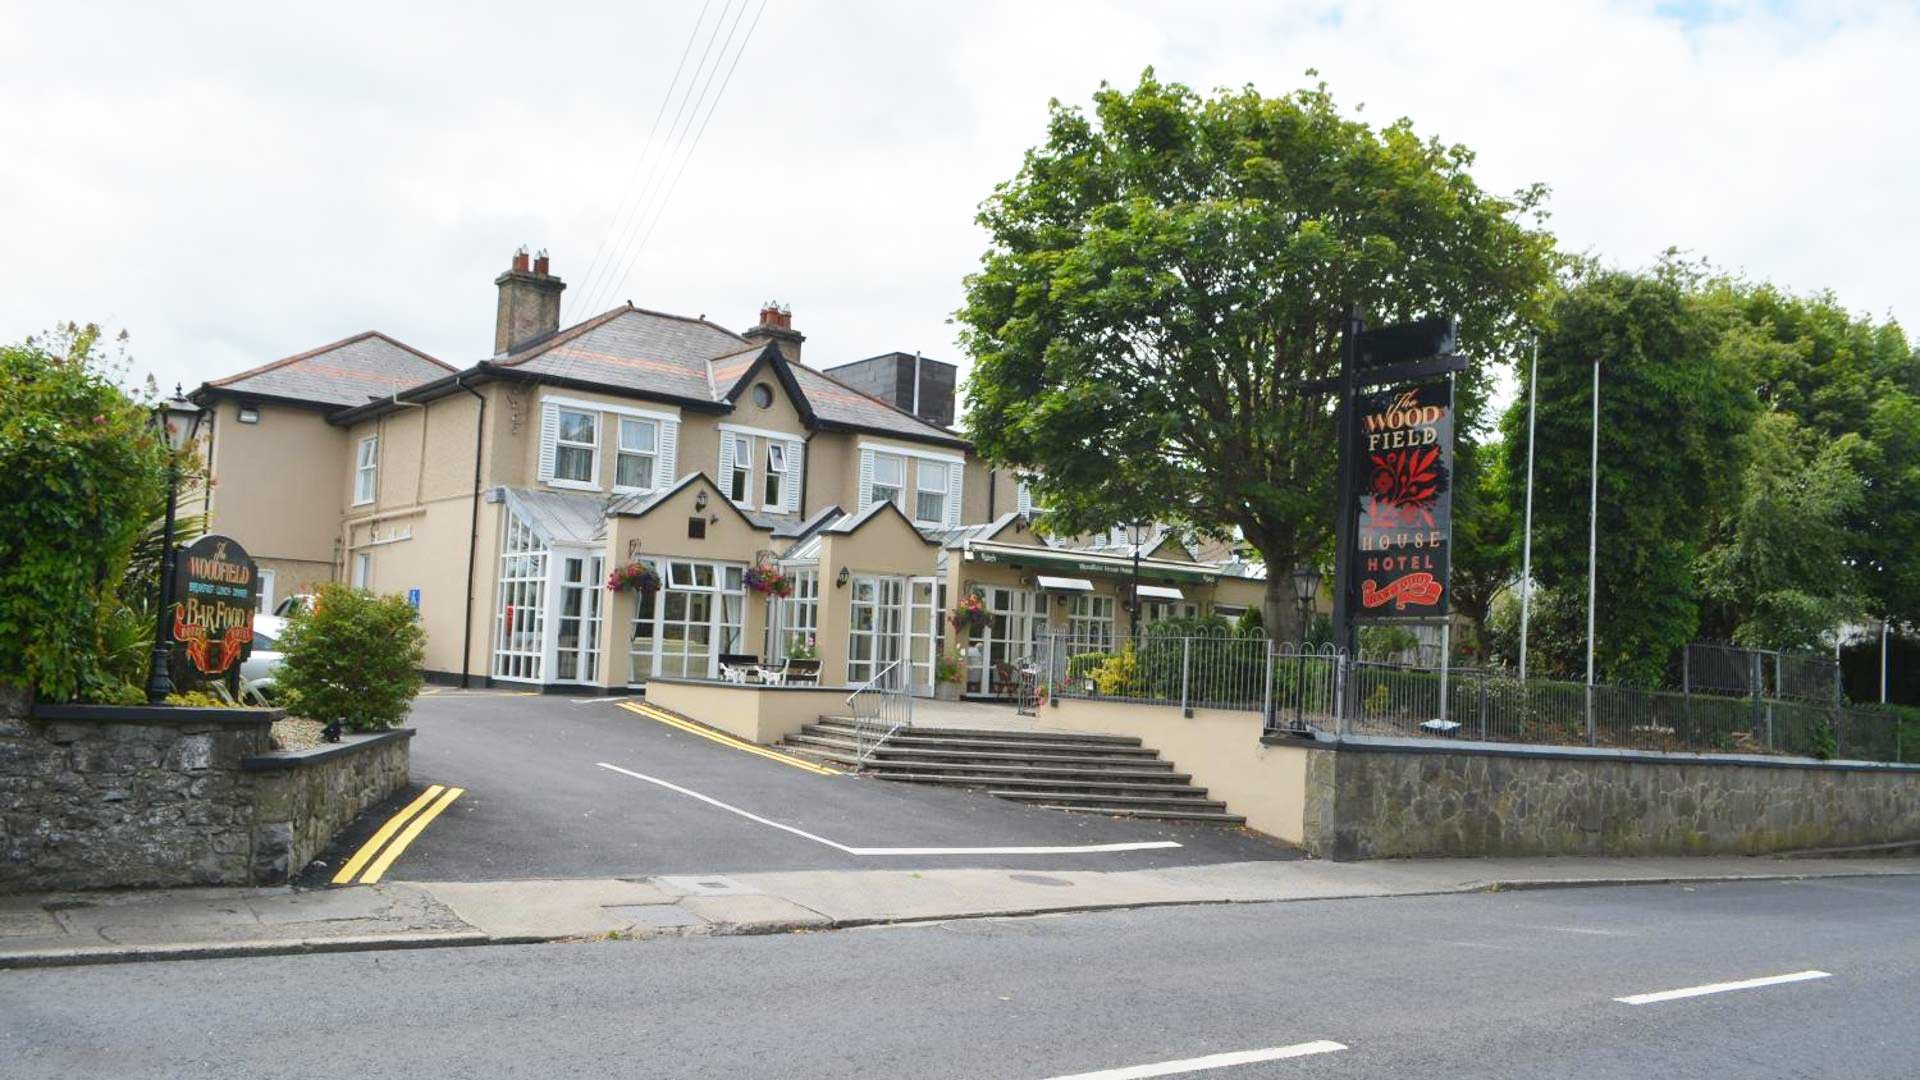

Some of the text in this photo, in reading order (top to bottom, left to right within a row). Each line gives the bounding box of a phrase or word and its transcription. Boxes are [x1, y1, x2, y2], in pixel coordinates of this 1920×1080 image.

[1386, 388, 1420, 416] The
[1363, 405, 1442, 431] WOOD
[1368, 427, 1438, 452] FIELD
[1362, 531, 1441, 551] HOUSE
[189, 556, 248, 584] WOODFIELD
[1367, 554, 1433, 572] HOTEL
